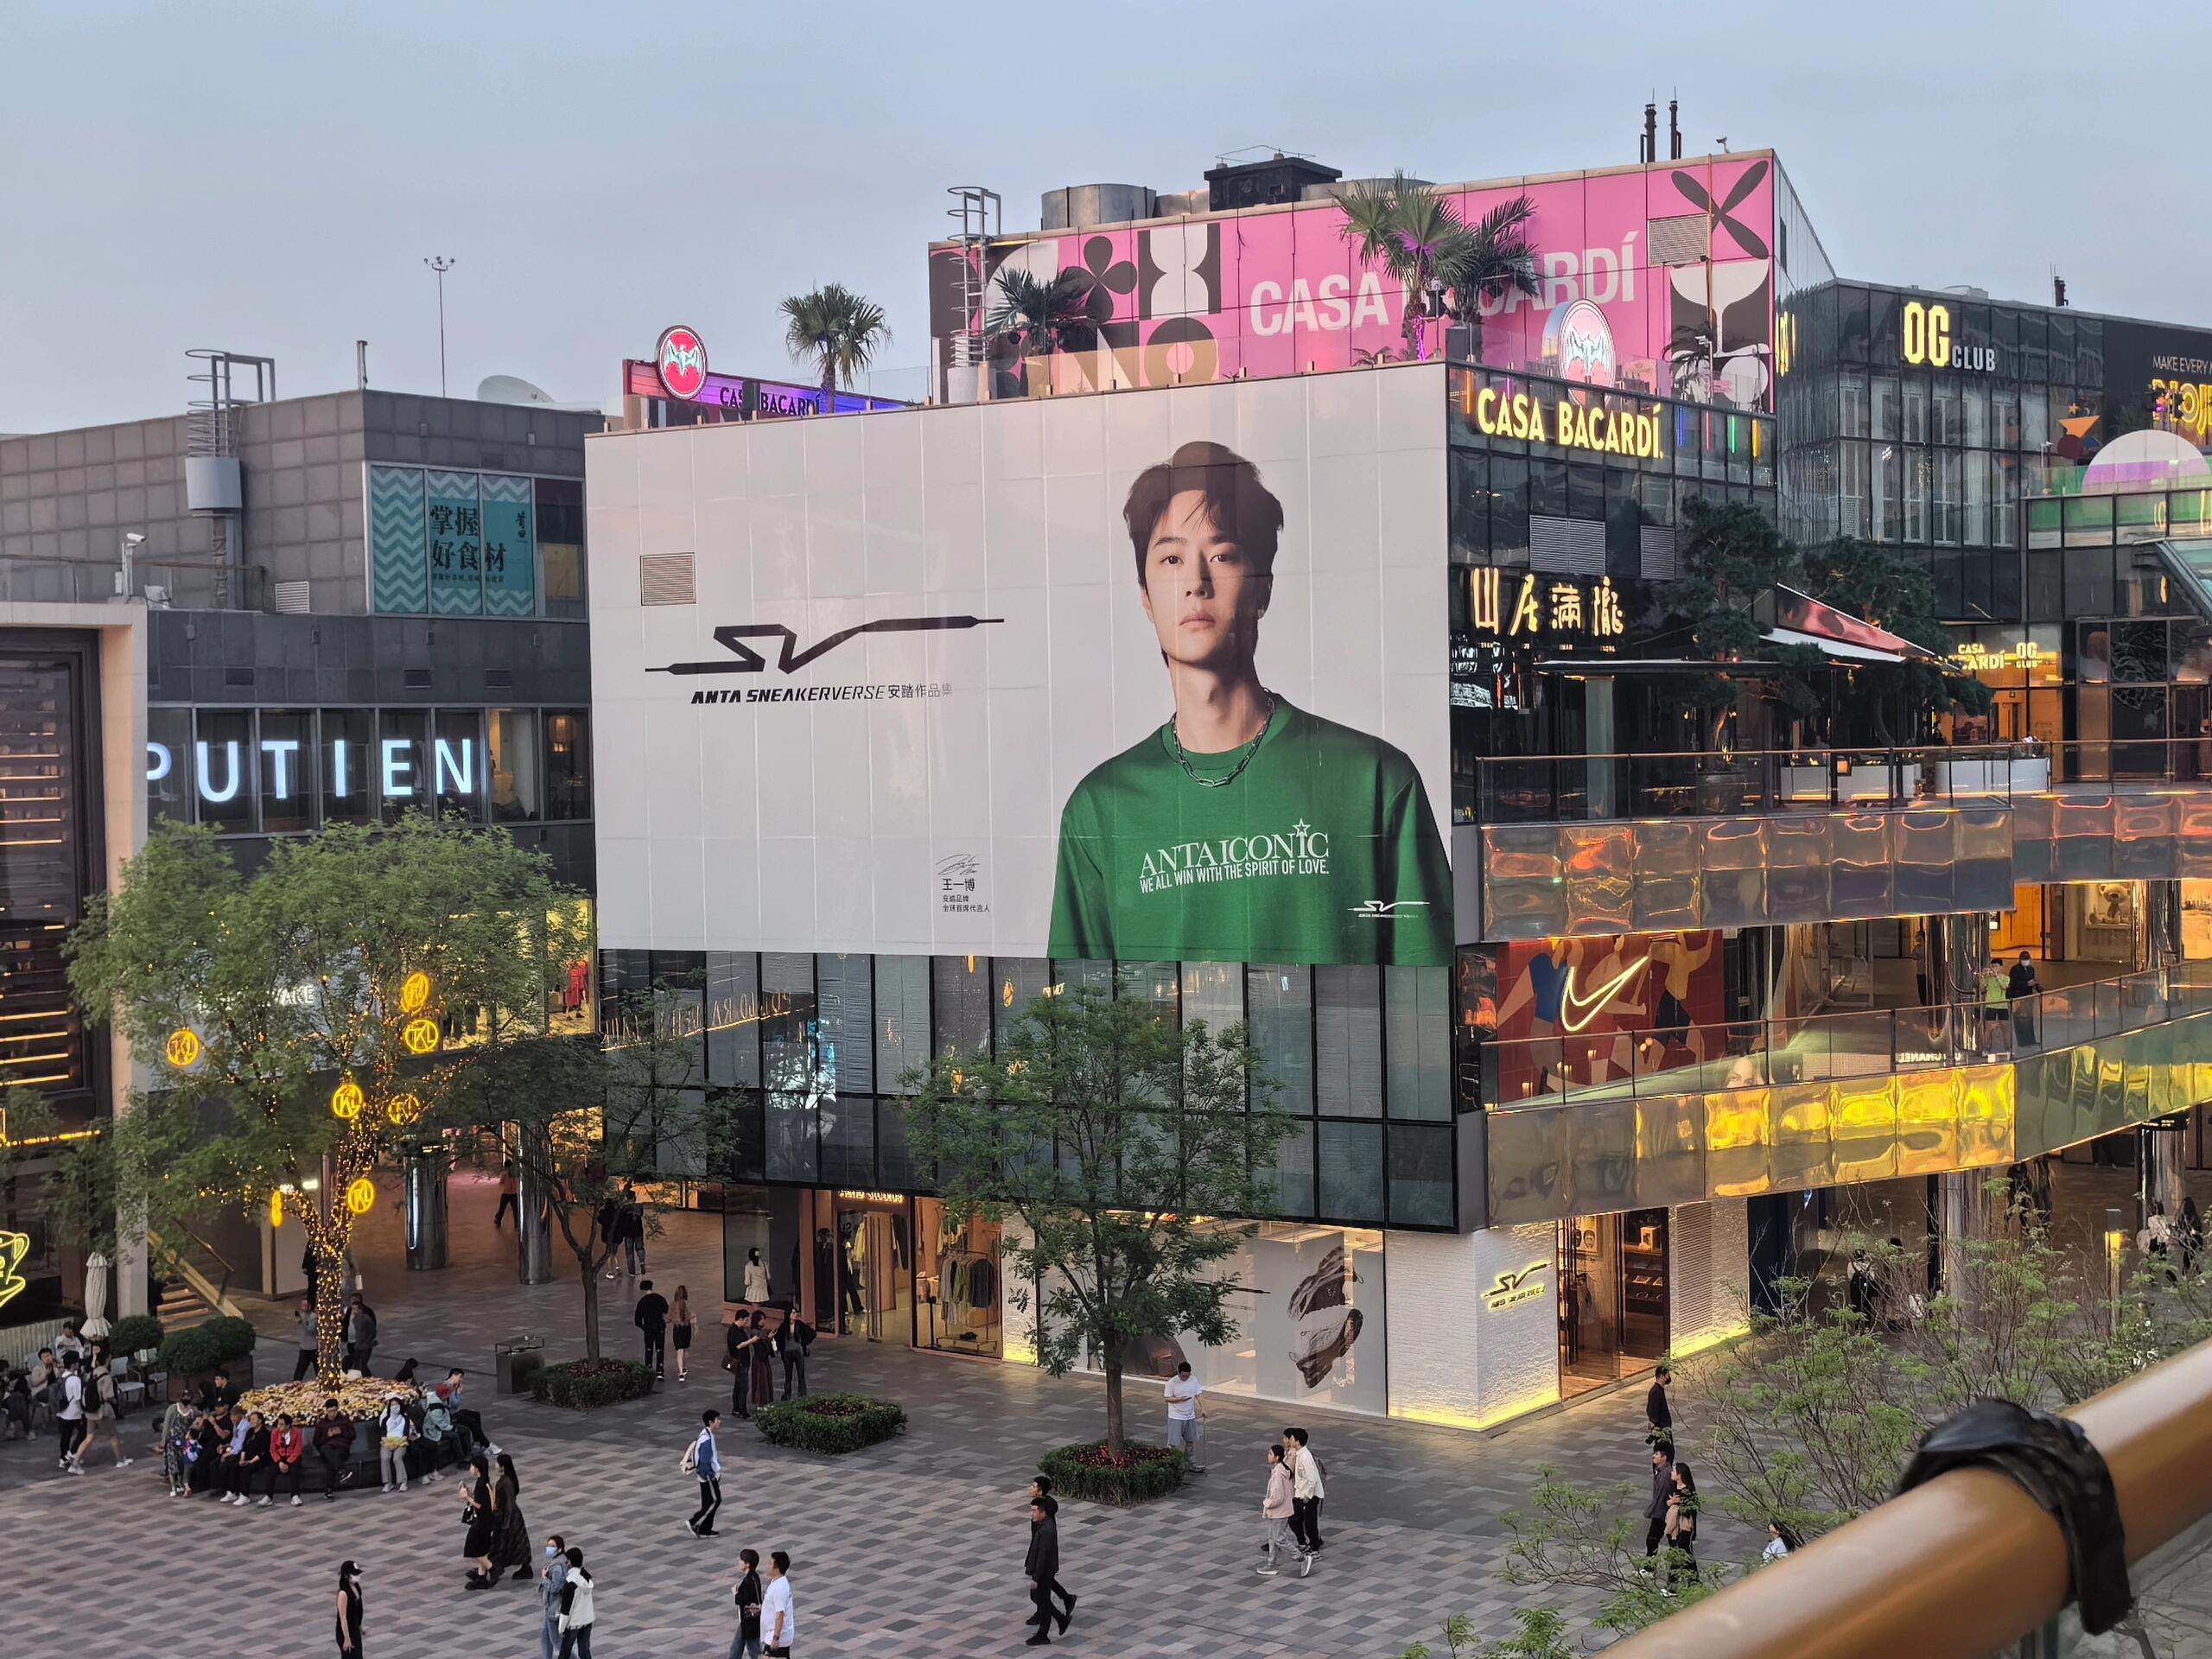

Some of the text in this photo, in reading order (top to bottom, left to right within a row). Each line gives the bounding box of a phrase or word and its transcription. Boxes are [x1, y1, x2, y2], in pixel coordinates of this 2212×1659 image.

[1250, 271, 1389, 336] CASA
[1904, 302, 1996, 372] OG CLUB
[2152, 354, 2209, 375] MAKE EVERY
[719, 386, 743, 408] CAS
[1478, 388, 1545, 442] CASA
[430, 505, 480, 536] 掌握
[432, 540, 506, 572] 好食材
[1957, 642, 2037, 658] CASA OG
[2016, 659, 2038, 668] CLUB
[690, 690, 741, 704] ANTA
[745, 685, 885, 703] SNEAKERVERSE
[1139, 831, 1329, 879] ANTAICONIC
[942, 878, 976, 891] 王一博
[1140, 858, 1330, 894] WE ALL WIN WITH THE SPIRIT OF LOVE.
